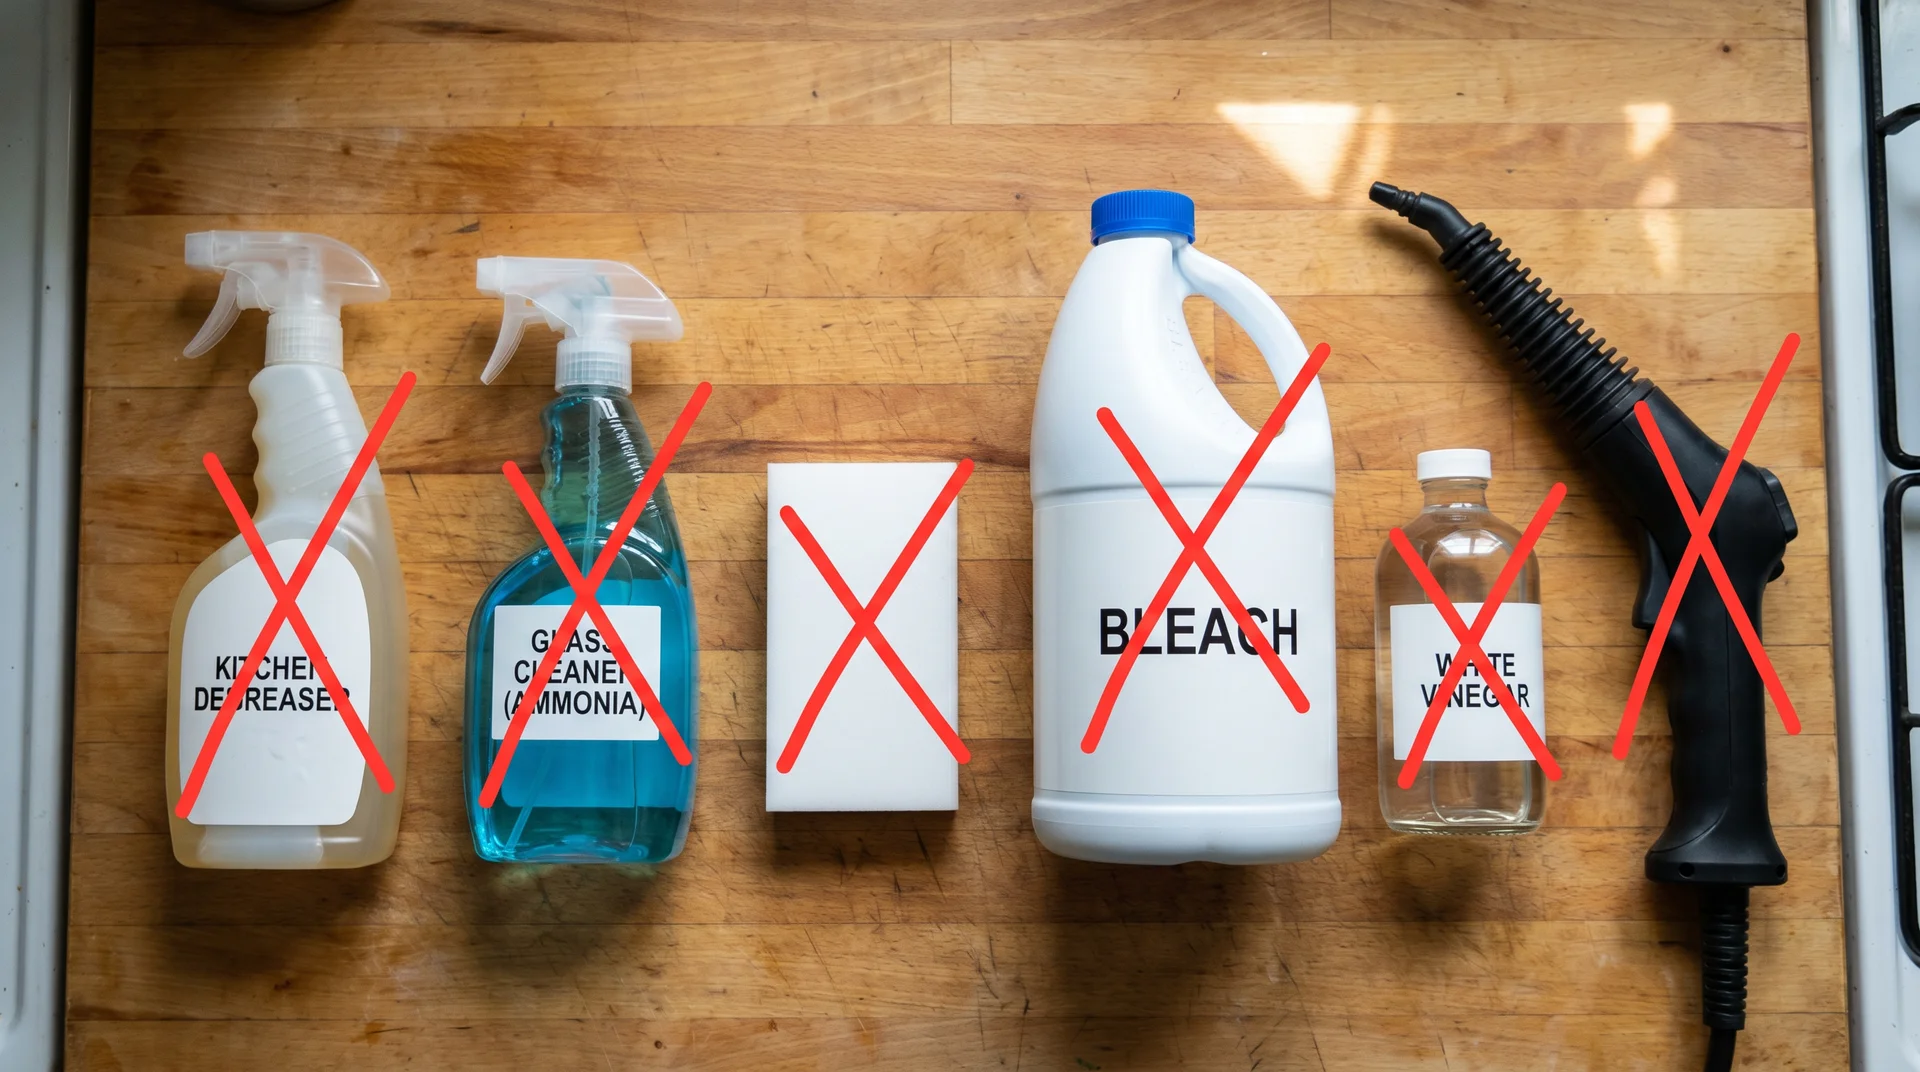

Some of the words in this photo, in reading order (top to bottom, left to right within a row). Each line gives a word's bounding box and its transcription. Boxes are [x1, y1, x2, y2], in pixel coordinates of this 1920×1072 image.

[531, 628, 615, 653] GAS
[1100, 607, 1298, 656] BLEACH
[215, 655, 328, 680] KICHE
[514, 659, 632, 684] CEANE
[1435, 653, 1516, 677] WTE
[194, 686, 350, 712] DEREASE
[504, 690, 646, 721] (AMMONIA)
[1420, 684, 1530, 708] VNEGR
